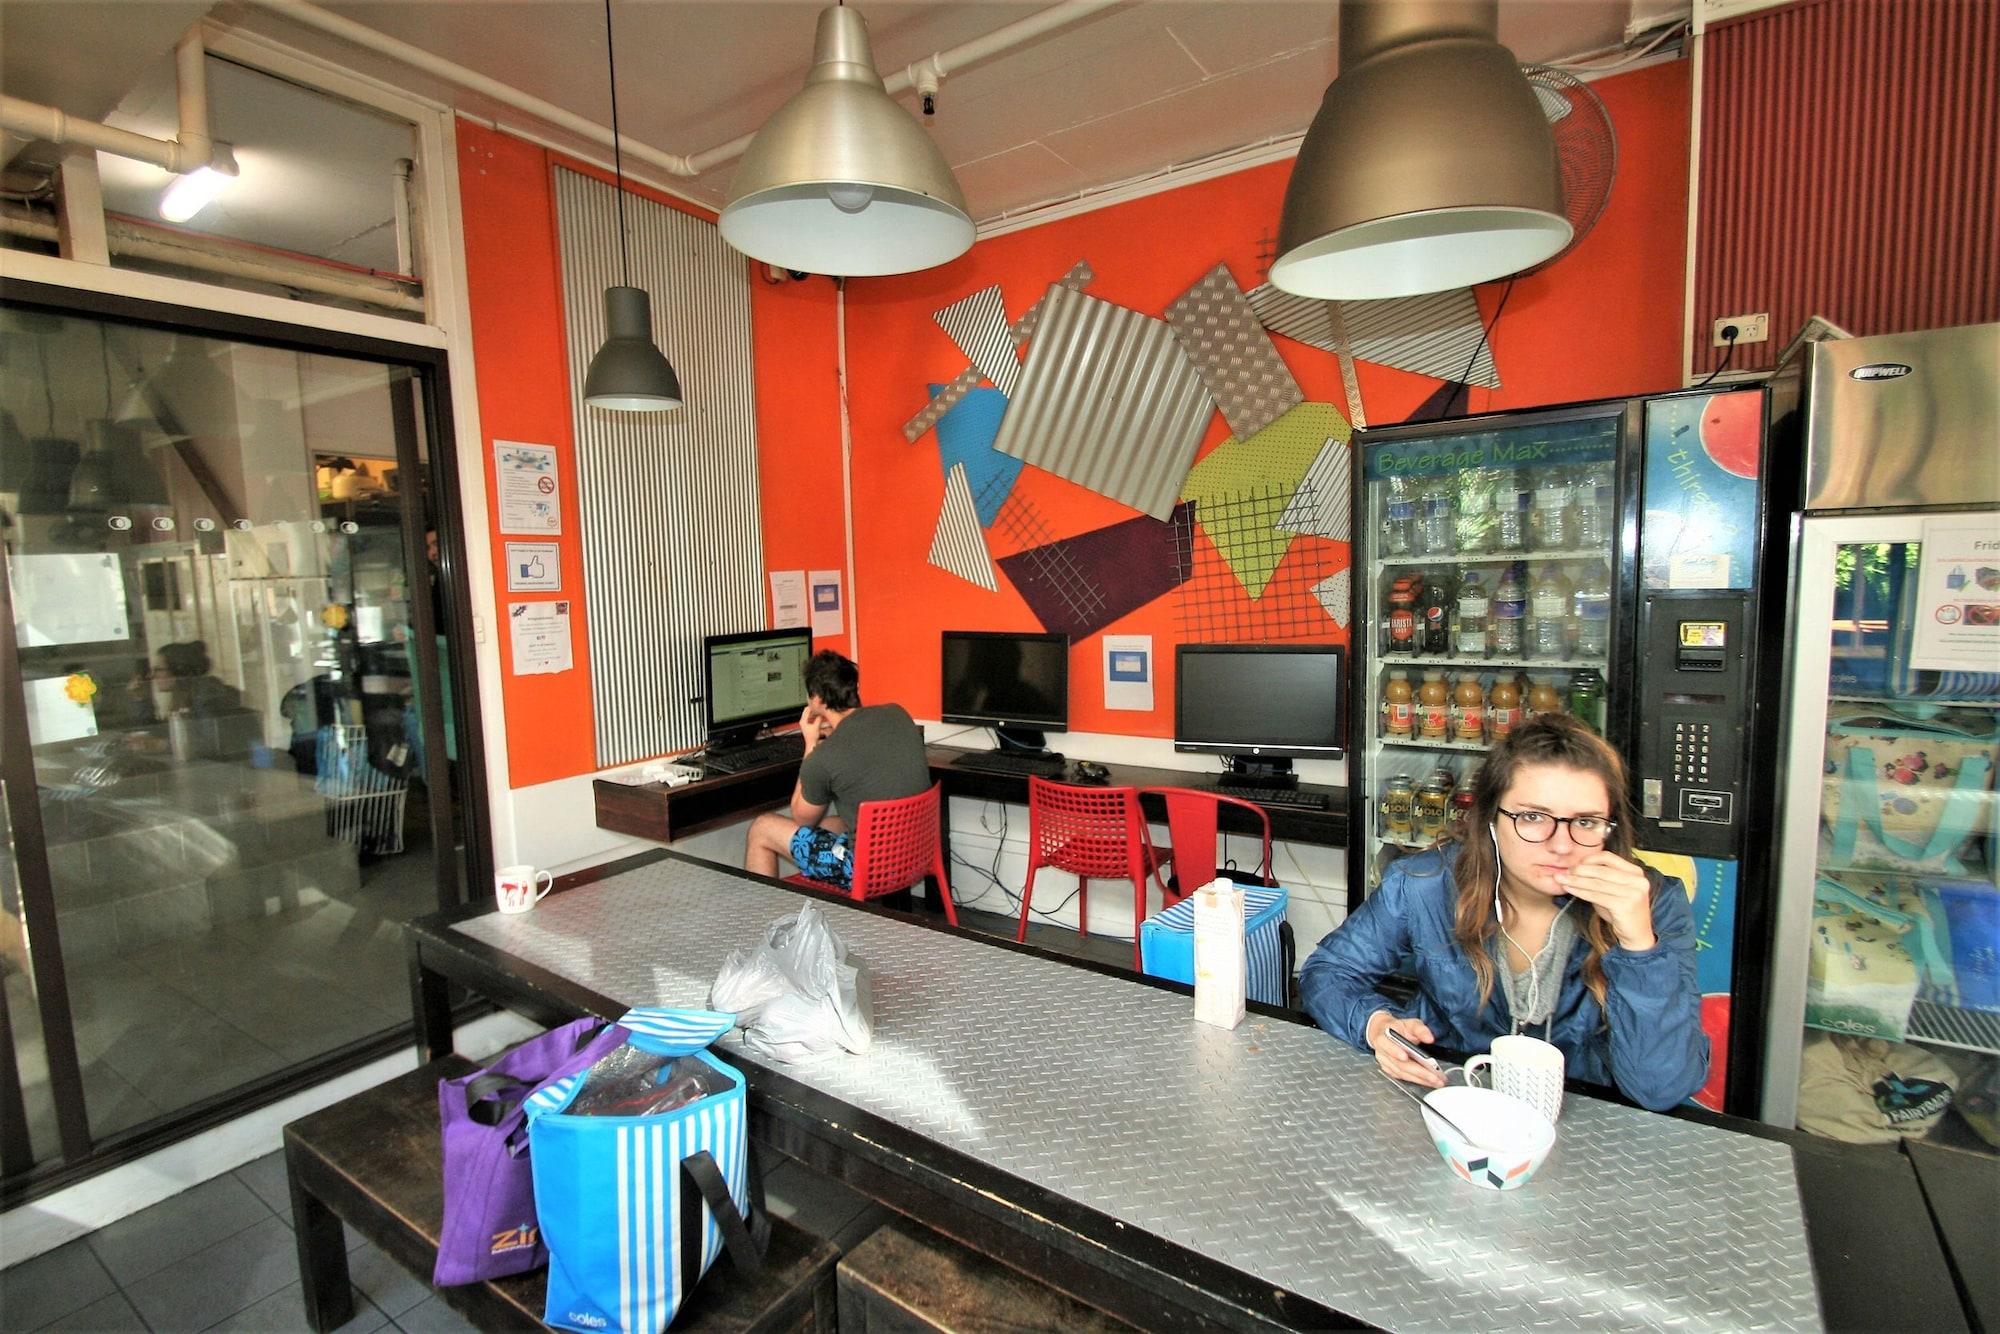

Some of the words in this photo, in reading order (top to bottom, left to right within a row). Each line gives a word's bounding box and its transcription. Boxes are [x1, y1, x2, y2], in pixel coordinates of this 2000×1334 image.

[1377, 449, 1484, 474] Beverage
[1494, 442, 1549, 461] Max
[1423, 808, 1443, 816] OLO
[1819, 1016, 1878, 1034] coles
